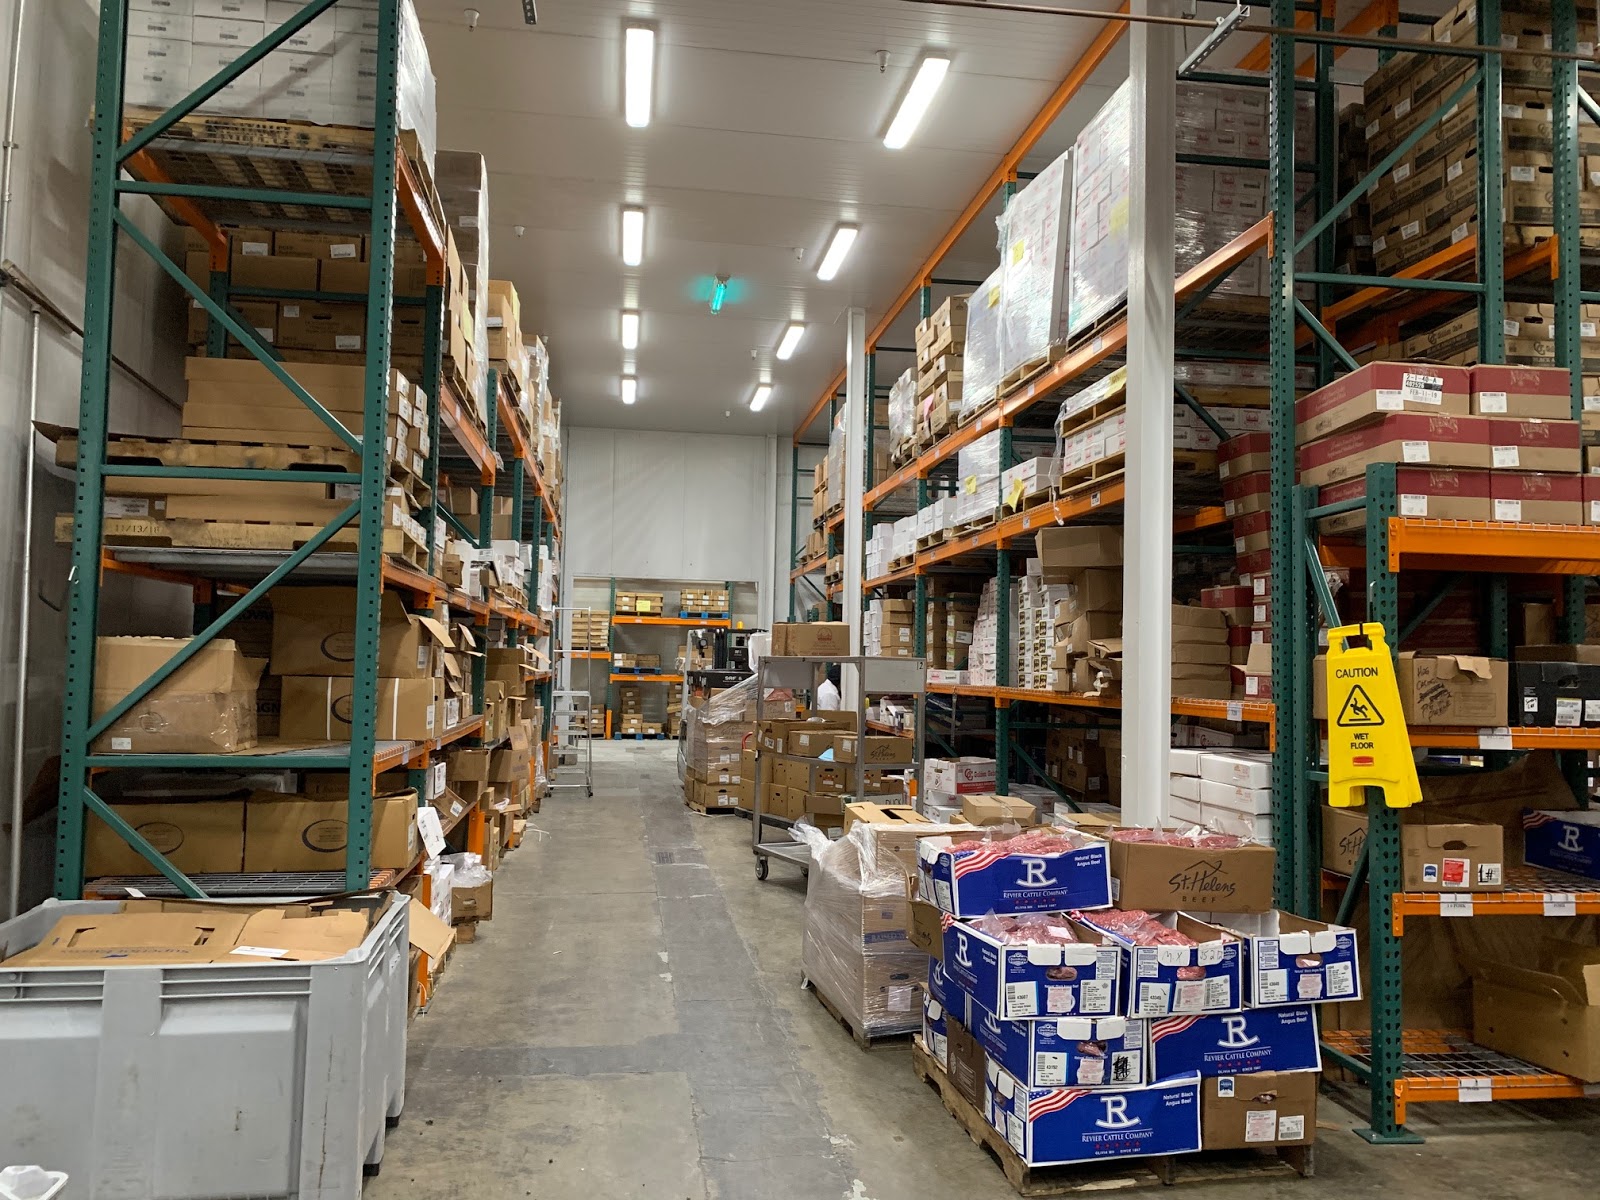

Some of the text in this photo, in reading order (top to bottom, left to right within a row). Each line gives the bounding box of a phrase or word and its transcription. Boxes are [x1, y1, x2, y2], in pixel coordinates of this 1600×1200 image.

[1336, 667, 1378, 678] CAUTION
[1562, 824, 1580, 852] R
[1020, 858, 1050, 888] R
[1003, 890, 1022, 899] REVIER
[1042, 889, 1068, 897] COMPANY
[1221, 1015, 1251, 1048] R
[1204, 1049, 1272, 1062] REVIER CATTLE COMPANY
[1100, 1094, 1131, 1130] R
[1082, 1131, 1153, 1143] REVIER CATTLE COMPANY
